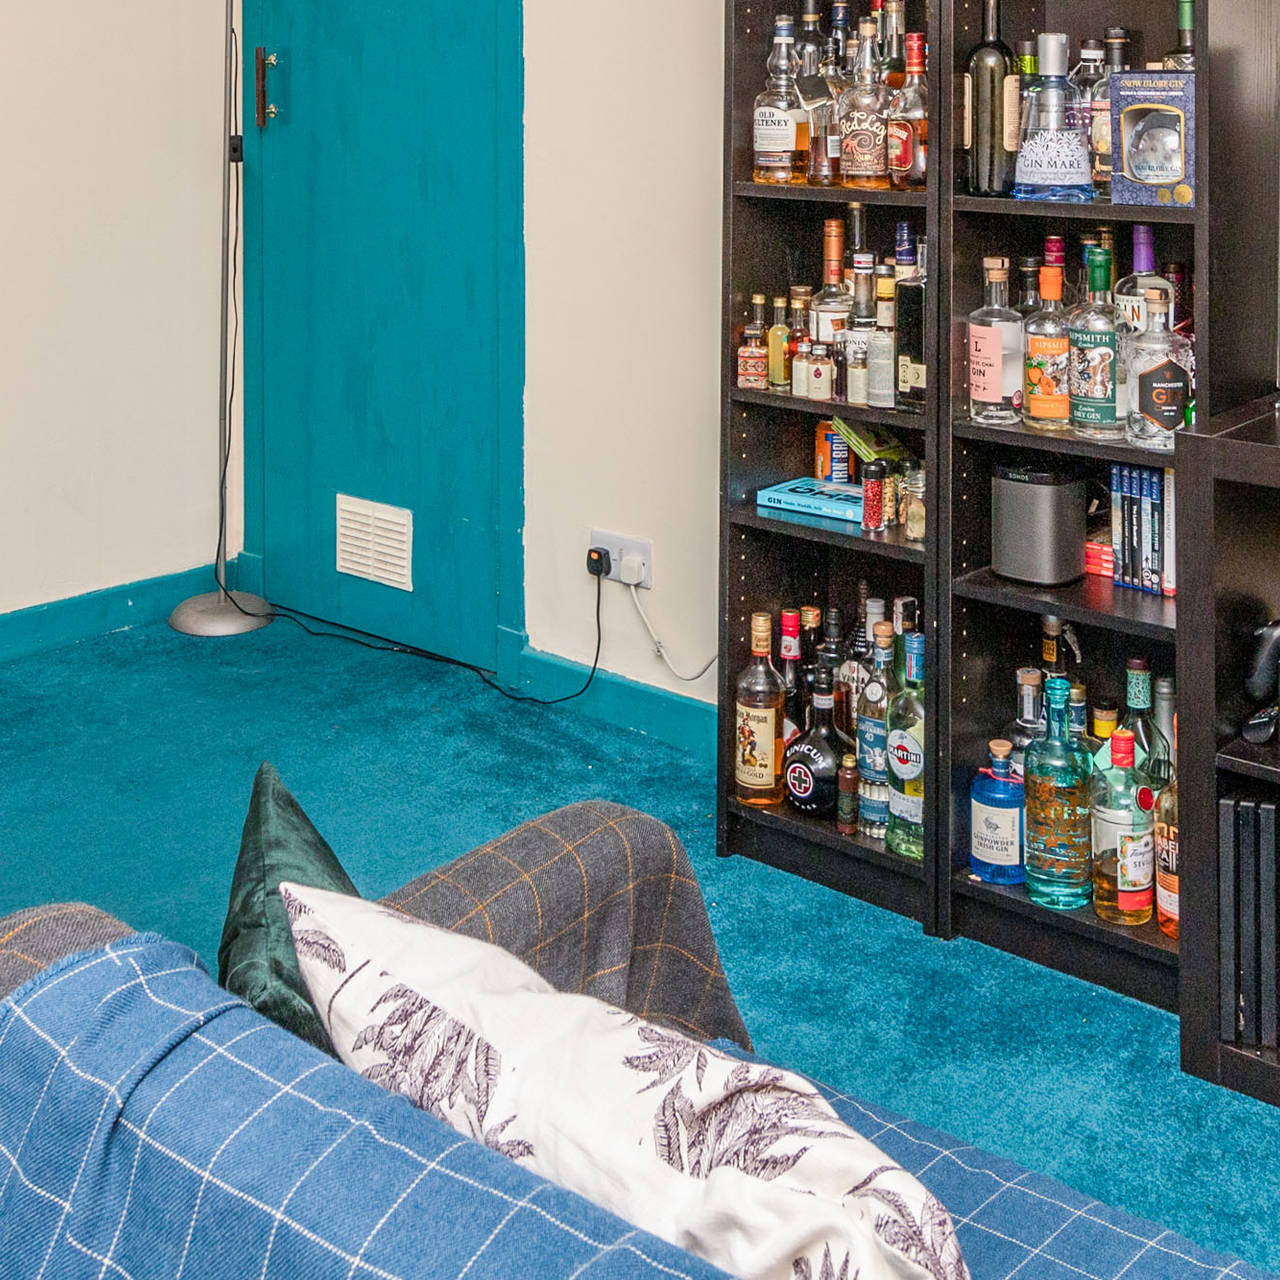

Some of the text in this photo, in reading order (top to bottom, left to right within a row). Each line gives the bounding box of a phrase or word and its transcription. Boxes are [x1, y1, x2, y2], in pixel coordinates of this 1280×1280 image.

[1121, 79, 1141, 88] SNOW
[1169, 79, 1184, 88] GIN
[758, 111, 775, 119] OLD
[1023, 157, 1083, 170] GIN MARE
[971, 367, 986, 377] GIN
[1087, 412, 1102, 420] GIN
[767, 496, 782, 506] GIN
[888, 744, 921, 765] MARTINI
